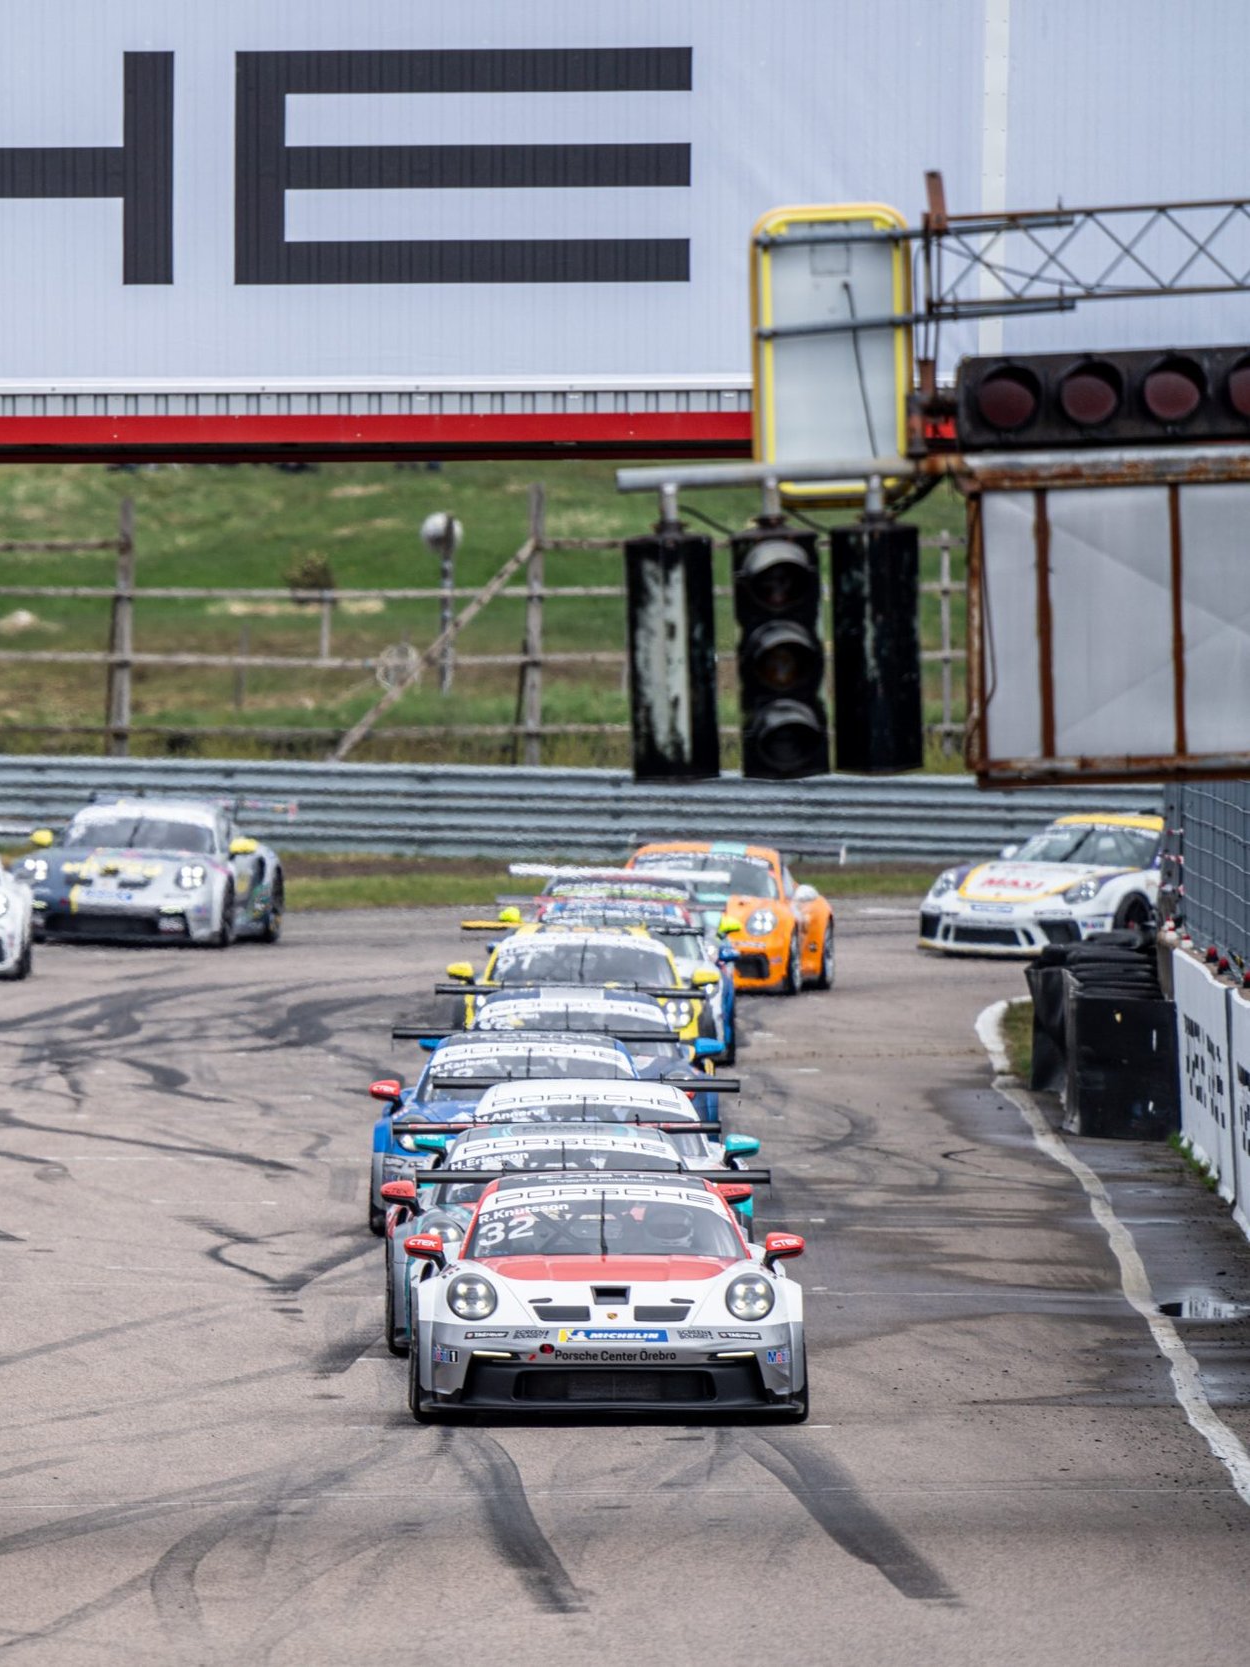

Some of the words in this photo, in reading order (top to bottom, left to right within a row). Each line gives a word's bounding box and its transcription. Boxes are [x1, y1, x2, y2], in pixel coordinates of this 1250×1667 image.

[462, 1138, 667, 1155] PORSCHE
[450, 1152, 530, 1171] H.Ericsson
[495, 1187, 716, 1206] PORSCHE
[478, 1202, 570, 1225] R.Knutsson
[478, 1217, 536, 1247] 32
[408, 1239, 439, 1249] CTEK
[771, 1239, 800, 1249] CTEK
[589, 1332, 660, 1341] MICHELIN
[554, 1350, 598, 1362] Porsche
[600, 1350, 637, 1361] Center
[639, 1347, 677, 1361] Örebro
